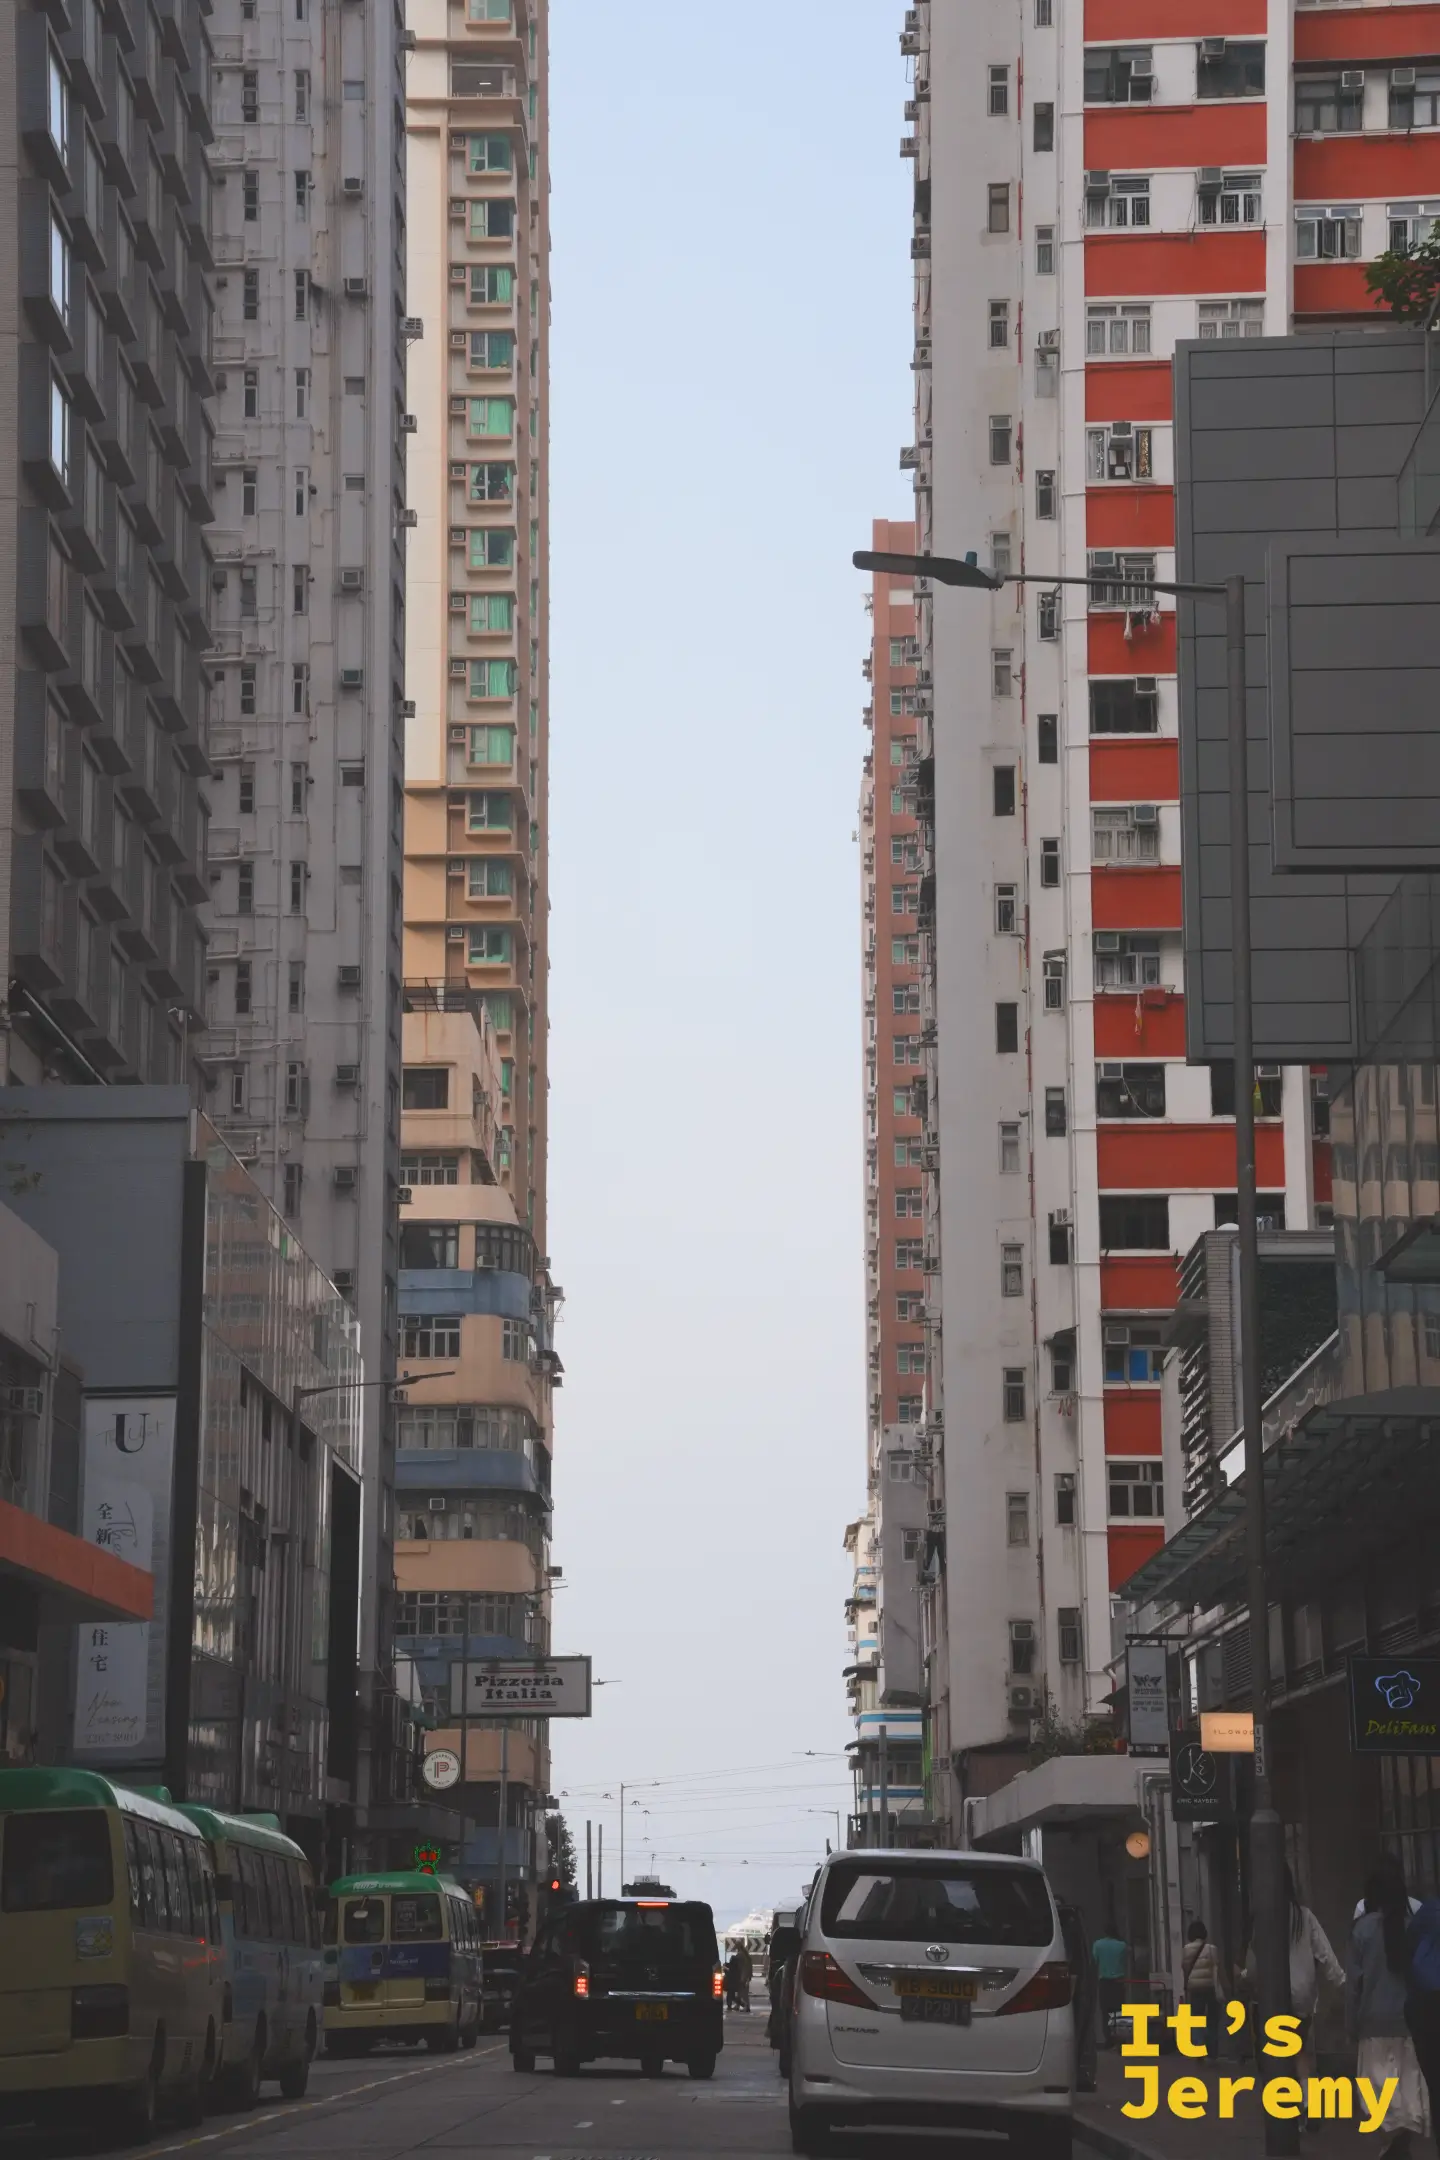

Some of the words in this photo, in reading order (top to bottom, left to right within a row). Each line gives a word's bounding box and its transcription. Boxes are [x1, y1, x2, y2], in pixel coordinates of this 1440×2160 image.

[474, 1675, 564, 1687] Pizzeria
[485, 1688, 553, 1699] Italia
[1365, 1719, 1437, 1736] DeliFans
